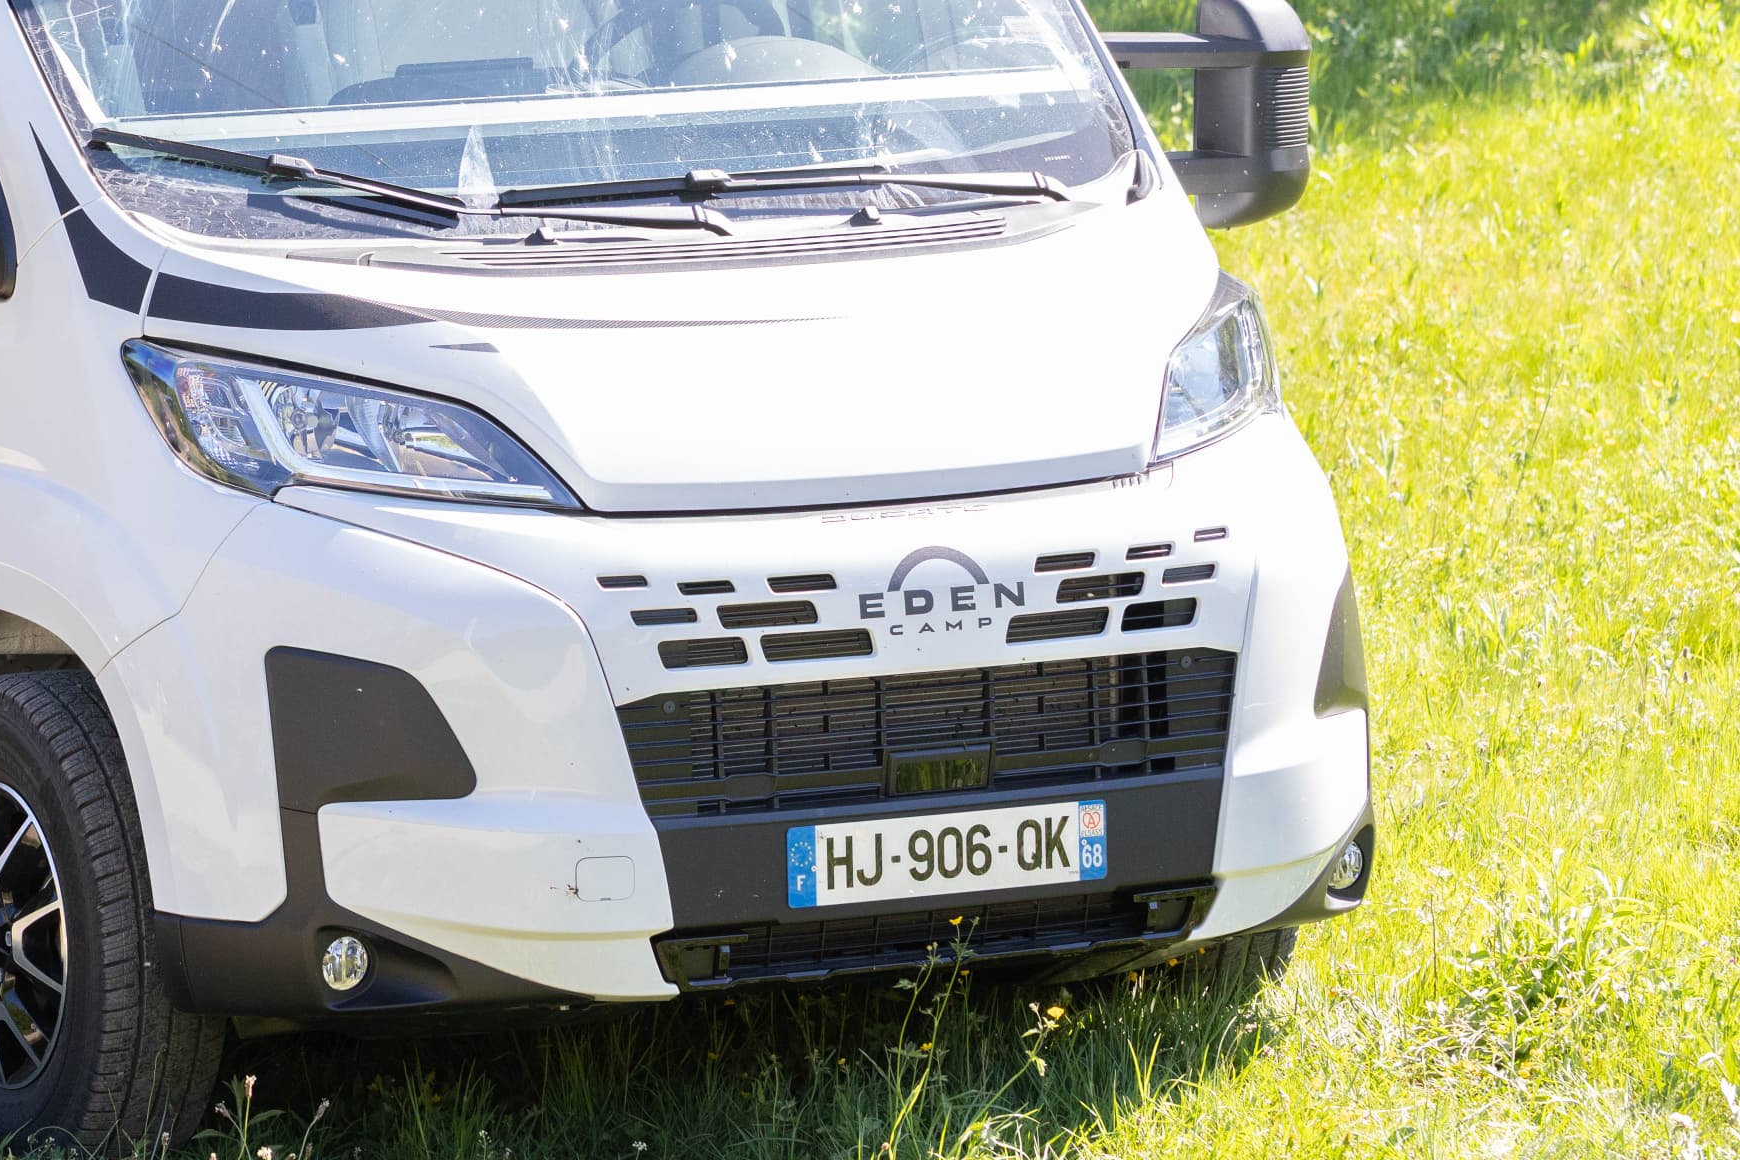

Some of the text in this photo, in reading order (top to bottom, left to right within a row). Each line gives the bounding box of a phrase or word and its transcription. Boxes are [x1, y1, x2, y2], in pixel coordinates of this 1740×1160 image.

[858, 581, 1026, 620] EDEN
[889, 617, 993, 636] CAMP
[826, 815, 1071, 890] HJ-906-QK
[1082, 843, 1103, 868] 68
[795, 873, 807, 892] F
